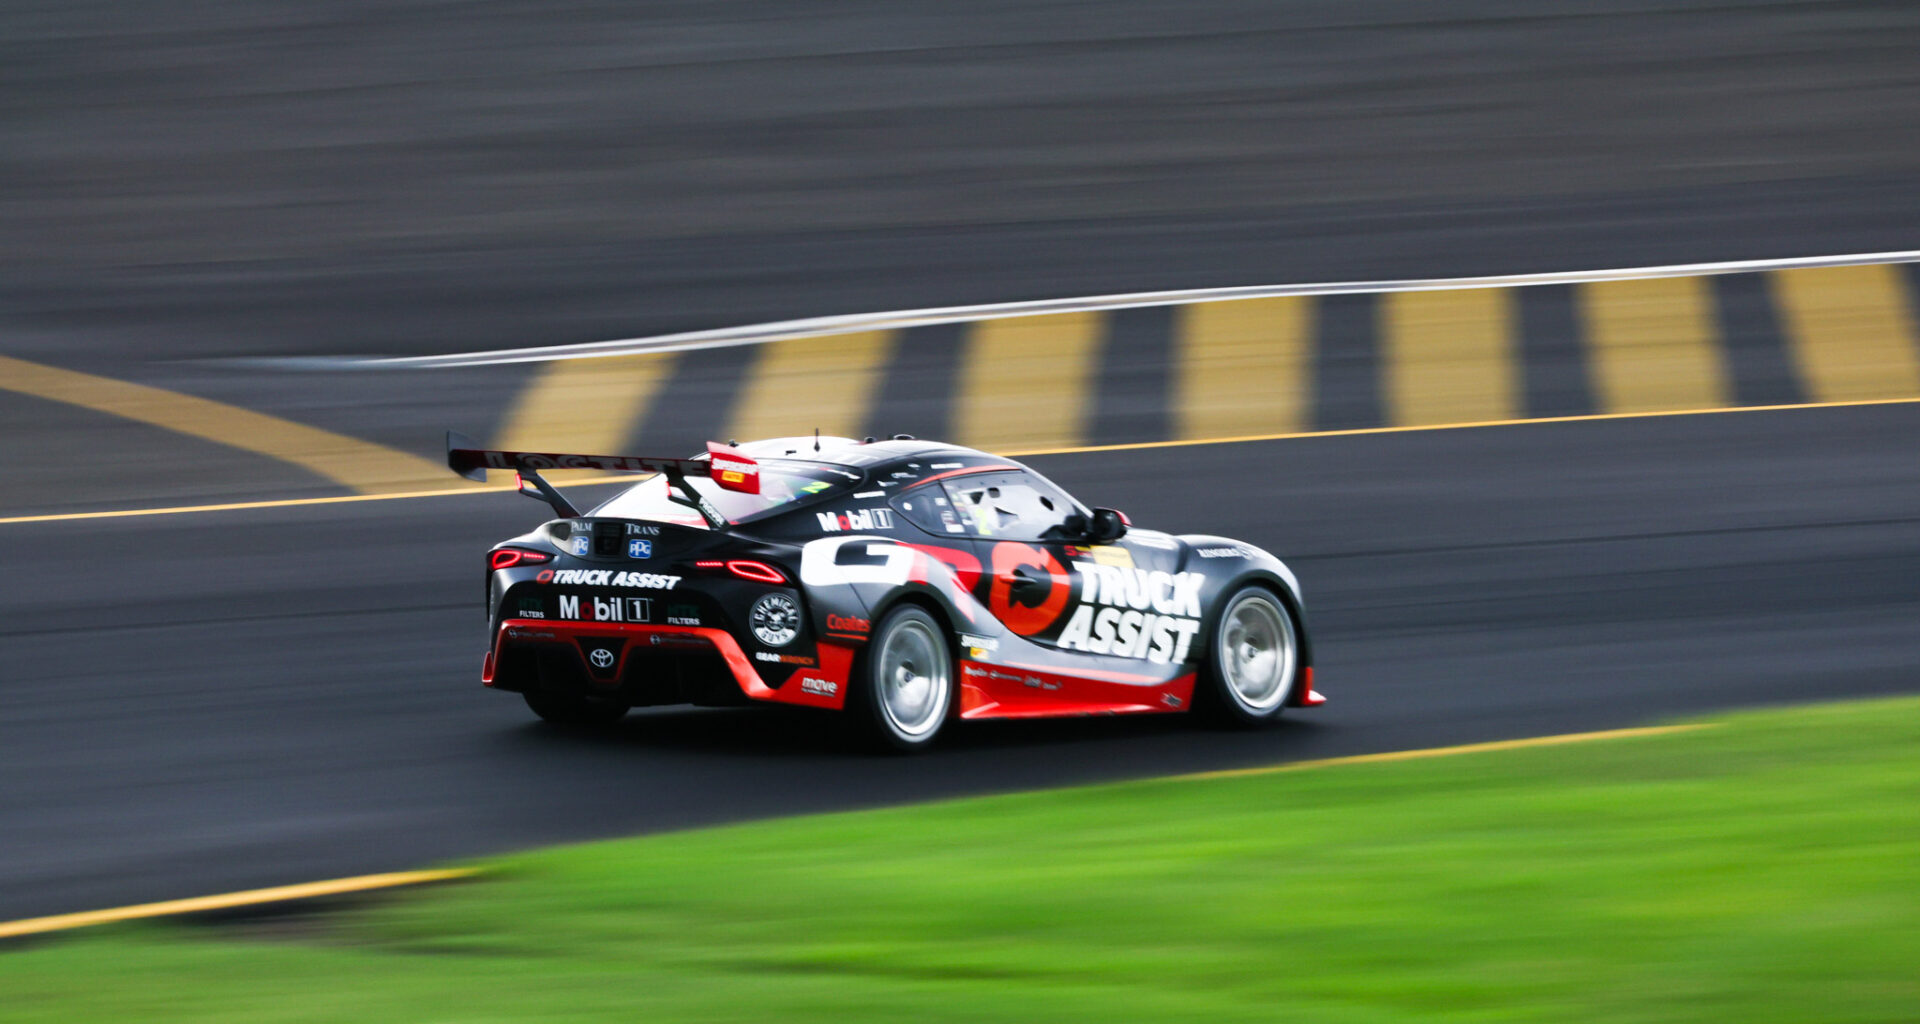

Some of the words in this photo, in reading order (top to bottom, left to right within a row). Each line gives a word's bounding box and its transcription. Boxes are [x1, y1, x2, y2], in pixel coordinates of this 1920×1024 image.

[571, 521, 592, 533] PALM
[625, 522, 660, 536] TRANS
[816, 508, 876, 532] Mobil
[630, 541, 651, 556] PPG
[553, 569, 611, 587] TRUCK
[612, 571, 682, 590] ASSIST
[1072, 561, 1206, 618] TRUCK
[519, 610, 545, 619] FILTERS
[559, 594, 623, 622] Mobil
[753, 596, 799, 621] CHEMICAL
[668, 617, 700, 626] FILTERS
[826, 613, 871, 632] Coates
[761, 630, 789, 643] GUYS
[1056, 604, 1201, 665] ASSIST
